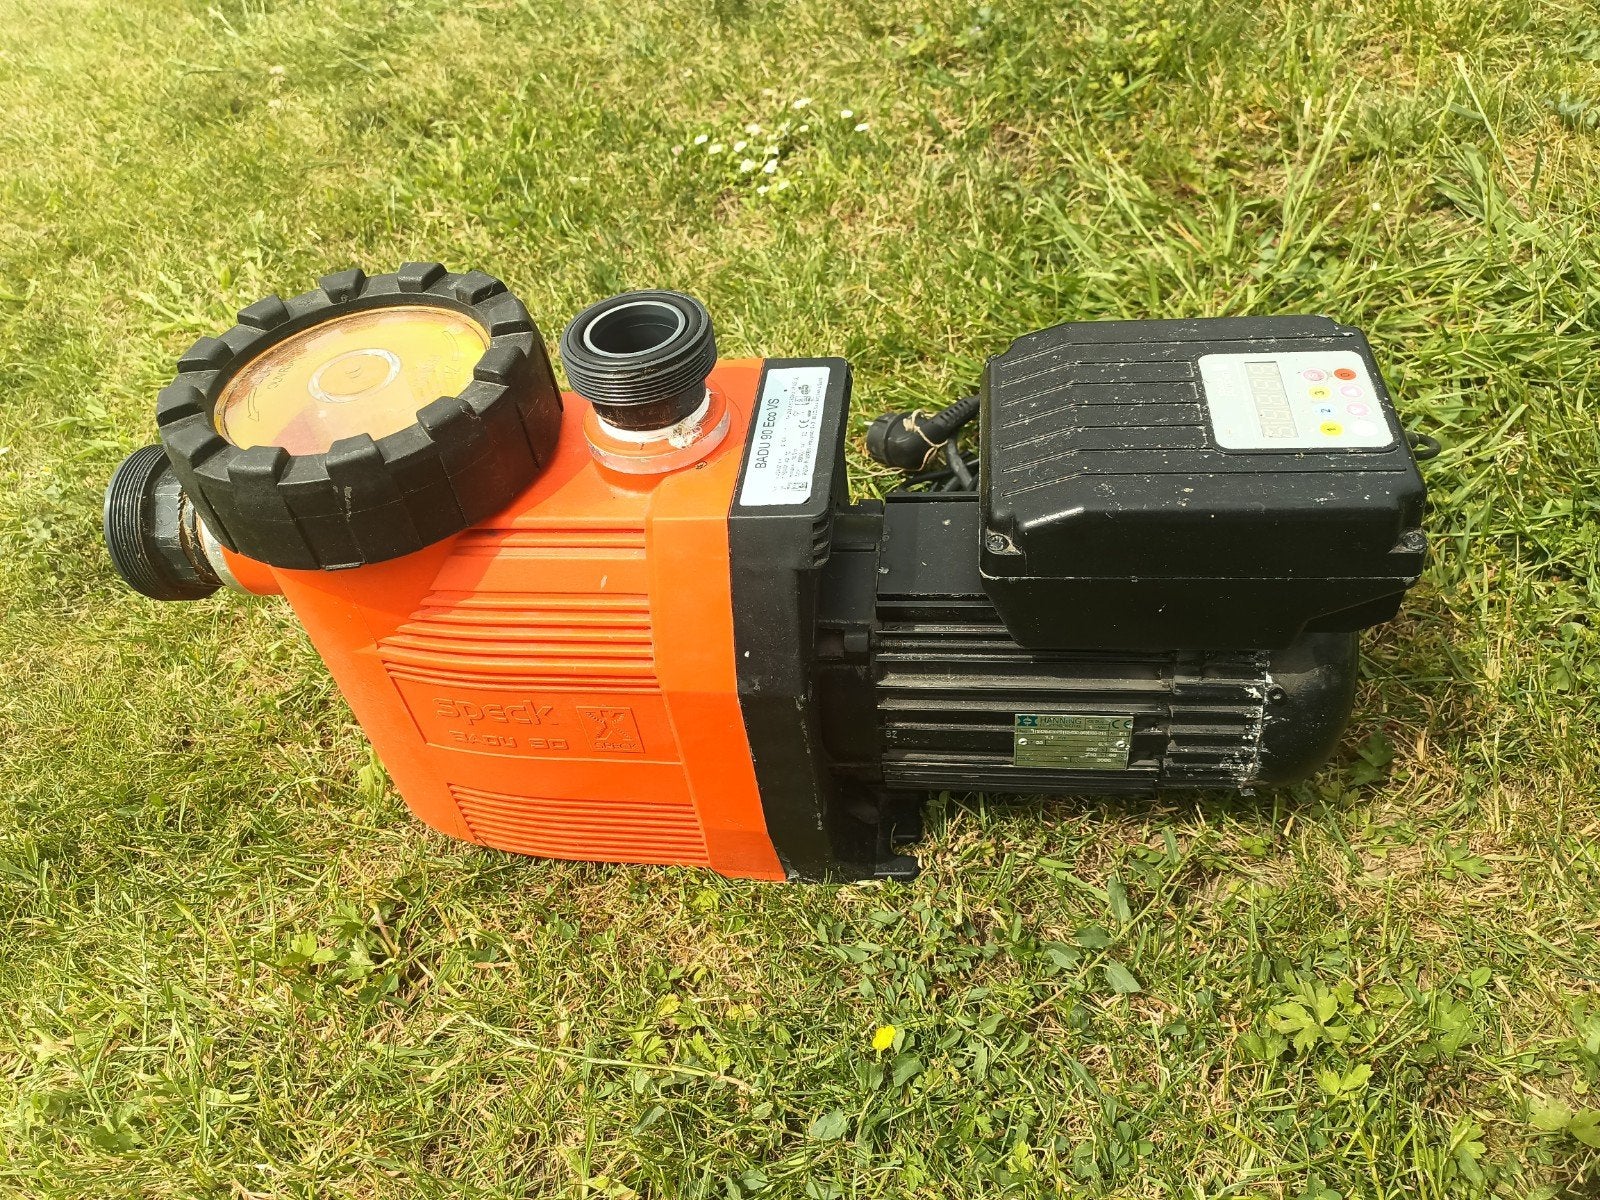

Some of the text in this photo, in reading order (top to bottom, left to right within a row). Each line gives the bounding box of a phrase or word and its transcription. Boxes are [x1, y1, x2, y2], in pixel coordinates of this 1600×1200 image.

[755, 398, 780, 469] BADU 90 Eco VS
[1040, 717, 1082, 725] HANNING
